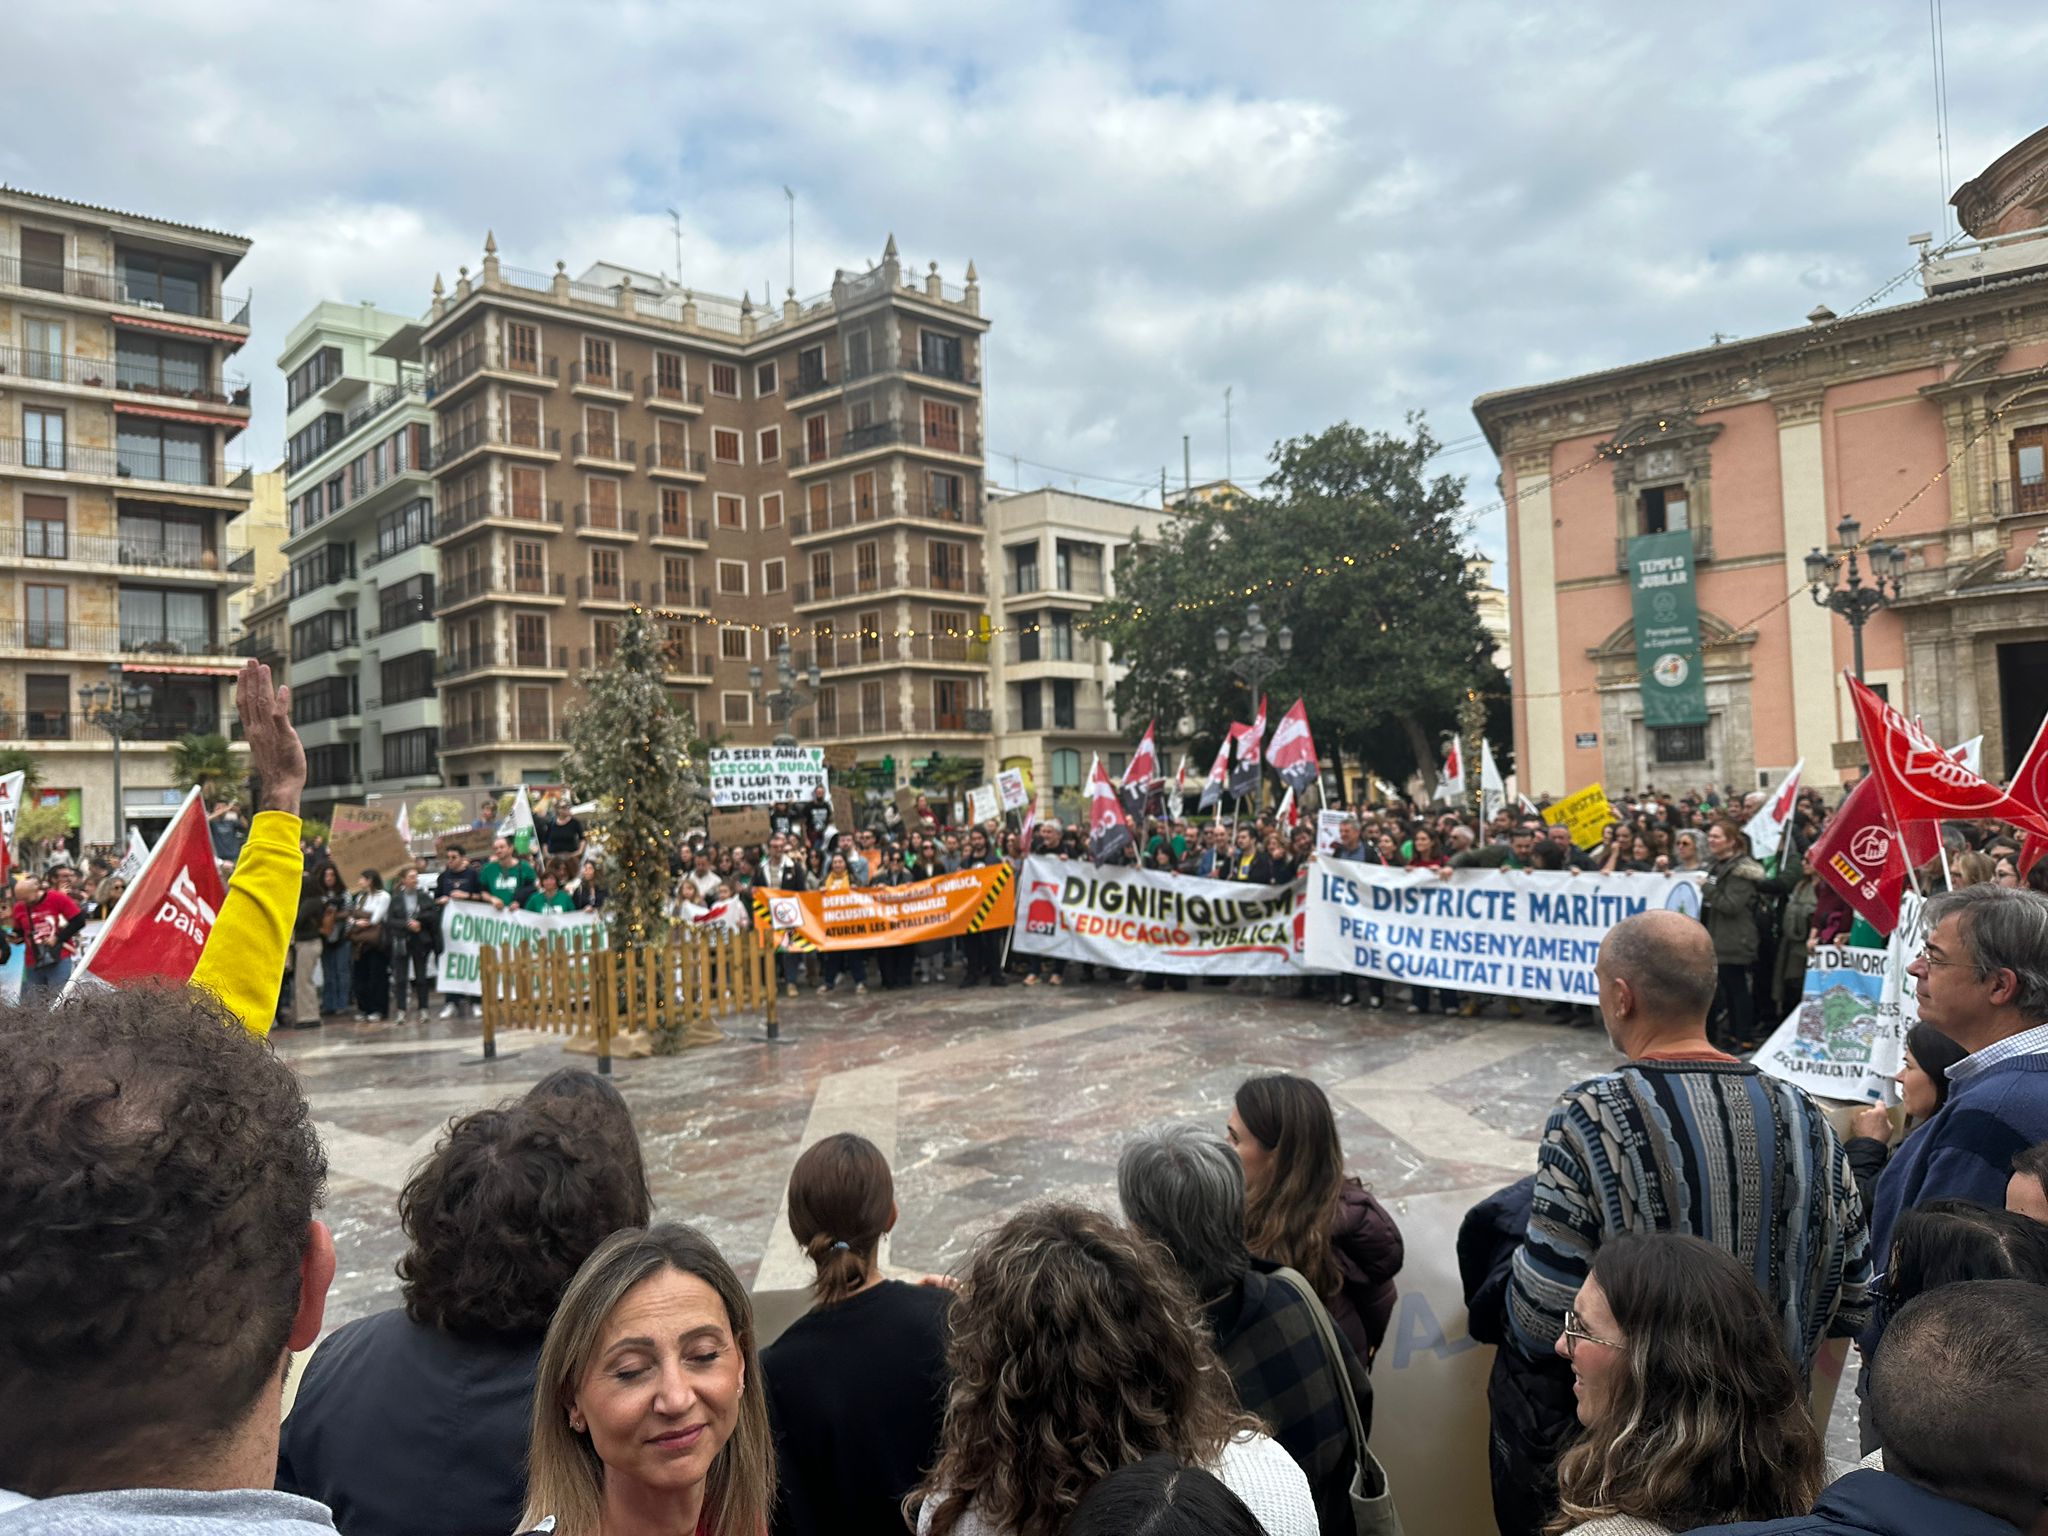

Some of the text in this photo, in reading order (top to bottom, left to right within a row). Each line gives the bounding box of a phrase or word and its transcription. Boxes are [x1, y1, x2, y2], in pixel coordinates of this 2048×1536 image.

[1638, 556, 1684, 574] TEMPLO
[1637, 570, 1688, 588] JUBILAR
[711, 750, 729, 761] LA
[779, 761, 822, 773] RURAL
[715, 776, 734, 789] EN
[799, 774, 822, 786] PER
[886, 903, 899, 917] DE
[901, 896, 948, 914] QUALITAT
[1061, 875, 1293, 928] DIGNIFIQUEM
[1321, 873, 1647, 929] IES DISTRICTE MARÍTIM
[826, 923, 867, 938] ATUREM
[871, 920, 886, 934] LES
[1028, 920, 1054, 934] CGT
[1339, 916, 1599, 965] PER UN ENSENYAMENT
[1354, 945, 1599, 996] DE QUALITAT I EN VAL
